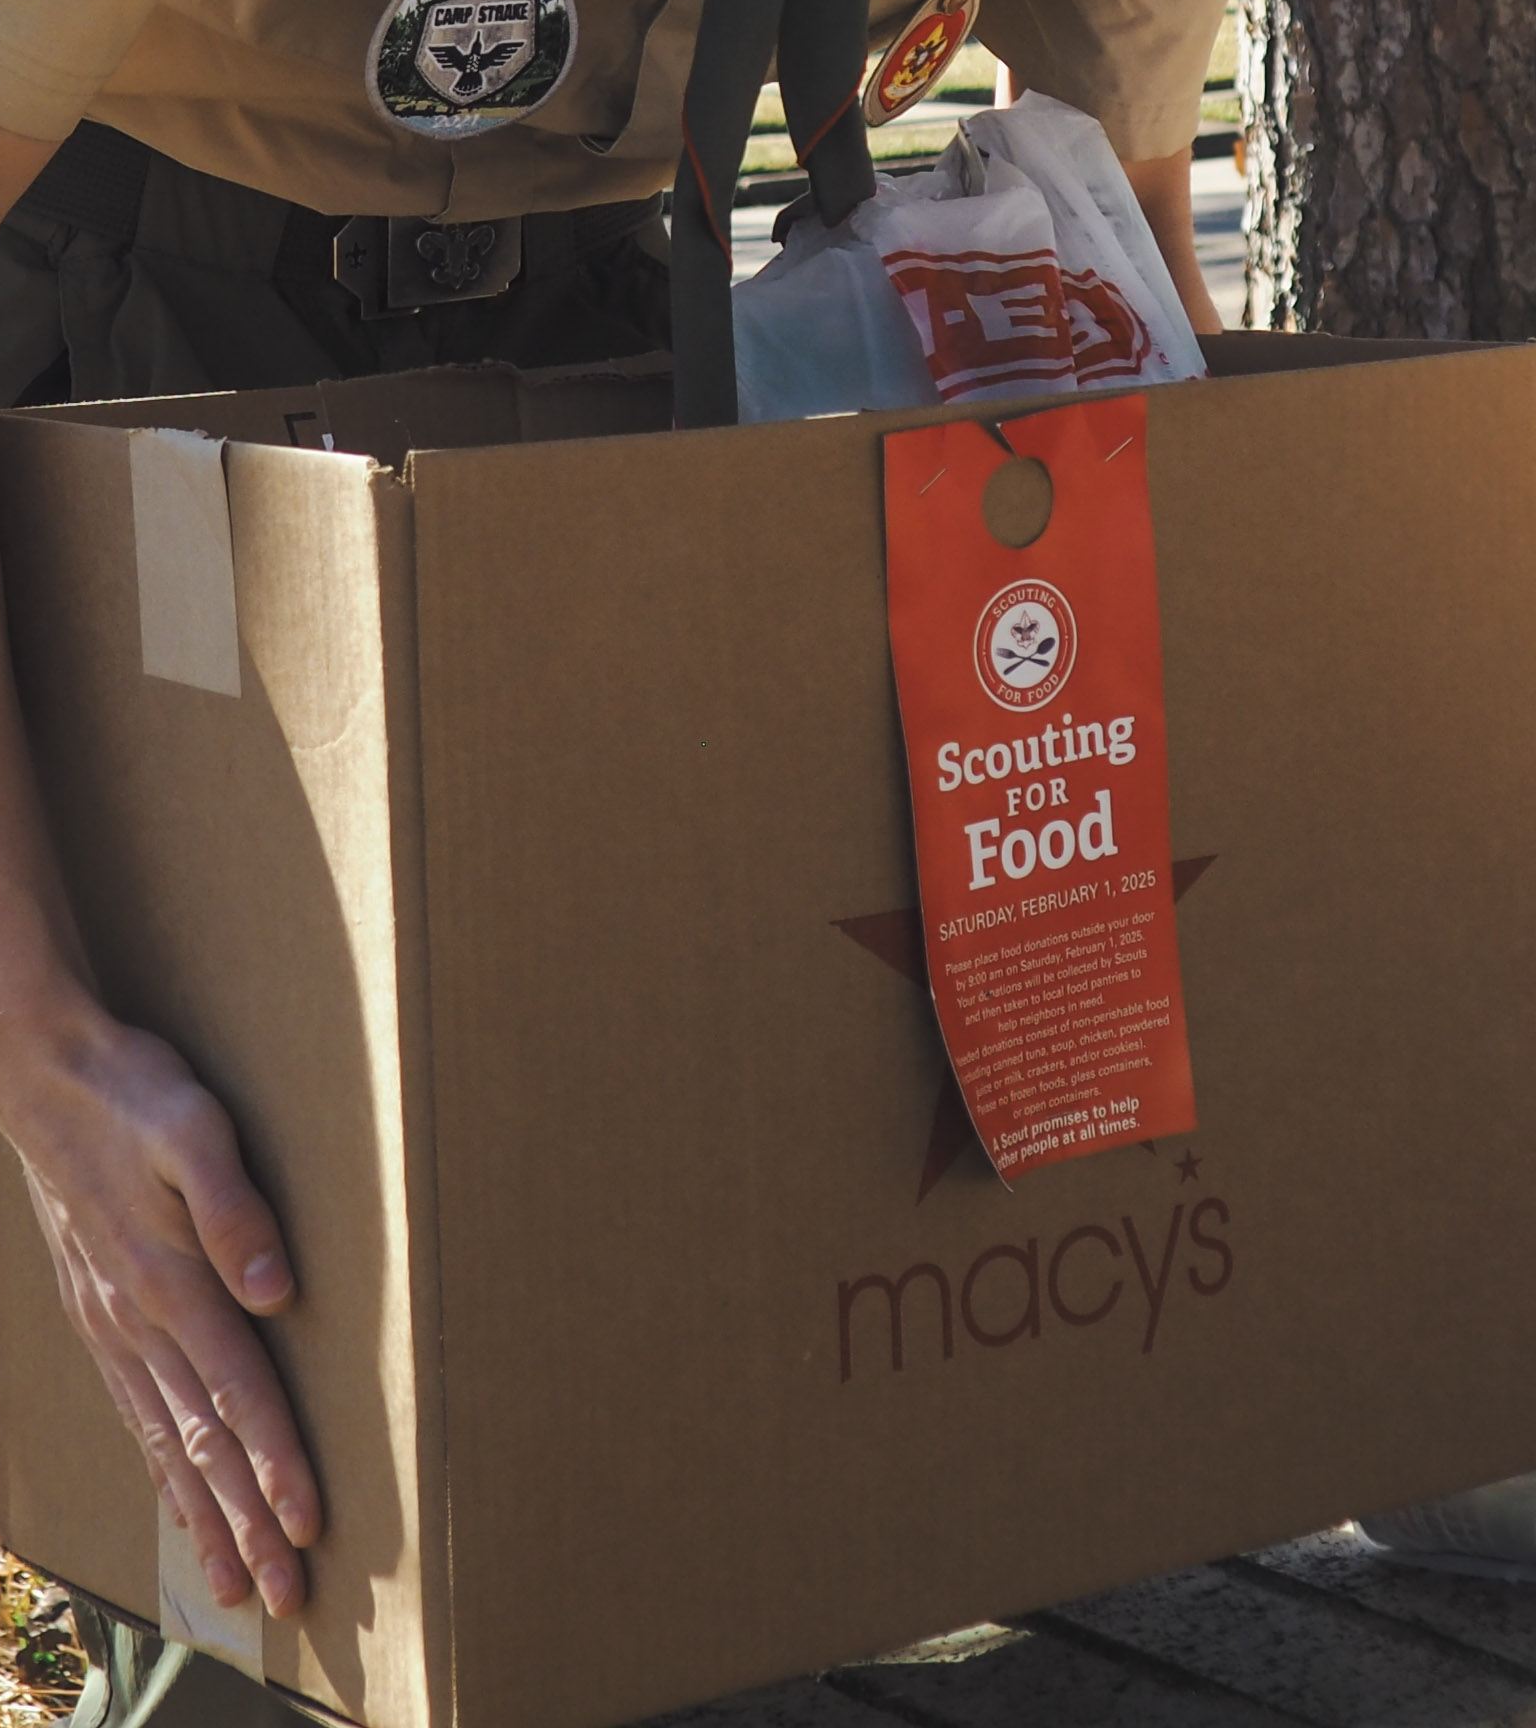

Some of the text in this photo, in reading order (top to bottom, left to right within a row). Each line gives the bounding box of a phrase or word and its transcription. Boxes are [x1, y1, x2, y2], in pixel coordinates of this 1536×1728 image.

[434, 2, 529, 27] CAMP STRAKE
[993, 588, 1057, 618] SCOUTING
[996, 673, 1060, 704] FOR FOOD
[937, 712, 1136, 792] Scouting
[1006, 777, 1069, 817] FOR
[964, 788, 1118, 891] Food
[939, 870, 1157, 942] SATURDAY, FEBRUARY 1, 2025
[945, 912, 1155, 976] Please place food donations outside your door
[955, 979, 966, 992] by
[968, 972, 987, 987] 9:00
[989, 969, 1004, 981] am
[1006, 965, 1019, 976] on
[1020, 953, 1064, 972] Saturday,
[1065, 940, 1107, 959] February
[1109, 937, 1118, 949] 1,
[957, 995, 976, 1009] Your
[1024, 975, 1041, 988] will
[1043, 972, 1055, 984] be
[1057, 960, 1098, 980] collected
[1100, 957, 1112, 969] by
[1114, 949, 1147, 965] Scouts
[965, 968, 1142, 1026] and then taken to local food pantries to
[981, 1036, 1023, 1056] donations
[1025, 1025, 1058, 1043] consist
[1060, 1019, 1070, 1031] of
[1072, 1002, 1144, 1029] non-perishable
[1146, 995, 1170, 1010] food
[993, 1053, 1023, 1071] canned
[1025, 1047, 1048, 1060] tuna,
[1051, 1039, 1077, 1053] soup,
[1080, 1029, 1117, 1046] chicken,
[1120, 1014, 1170, 1036] powdered
[998, 1018, 1018, 1033] help
[1020, 1006, 1065, 1026] neighbors
[1068, 1000, 1077, 1012] in
[994, 1080, 1003, 1089] or
[1027, 1060, 1067, 1078] crackers,
[1070, 1052, 1100, 1069] and/or
[1010, 1086, 1037, 1102] frozen
[1070, 1069, 1096, 1087] glass
[1098, 1056, 1153, 1077] containers,
[992, 1096, 1140, 1152] A Scout promises to help
[1012, 1087, 1102, 1119] or open containers.
[997, 1116, 1141, 1171] other people at all times.
